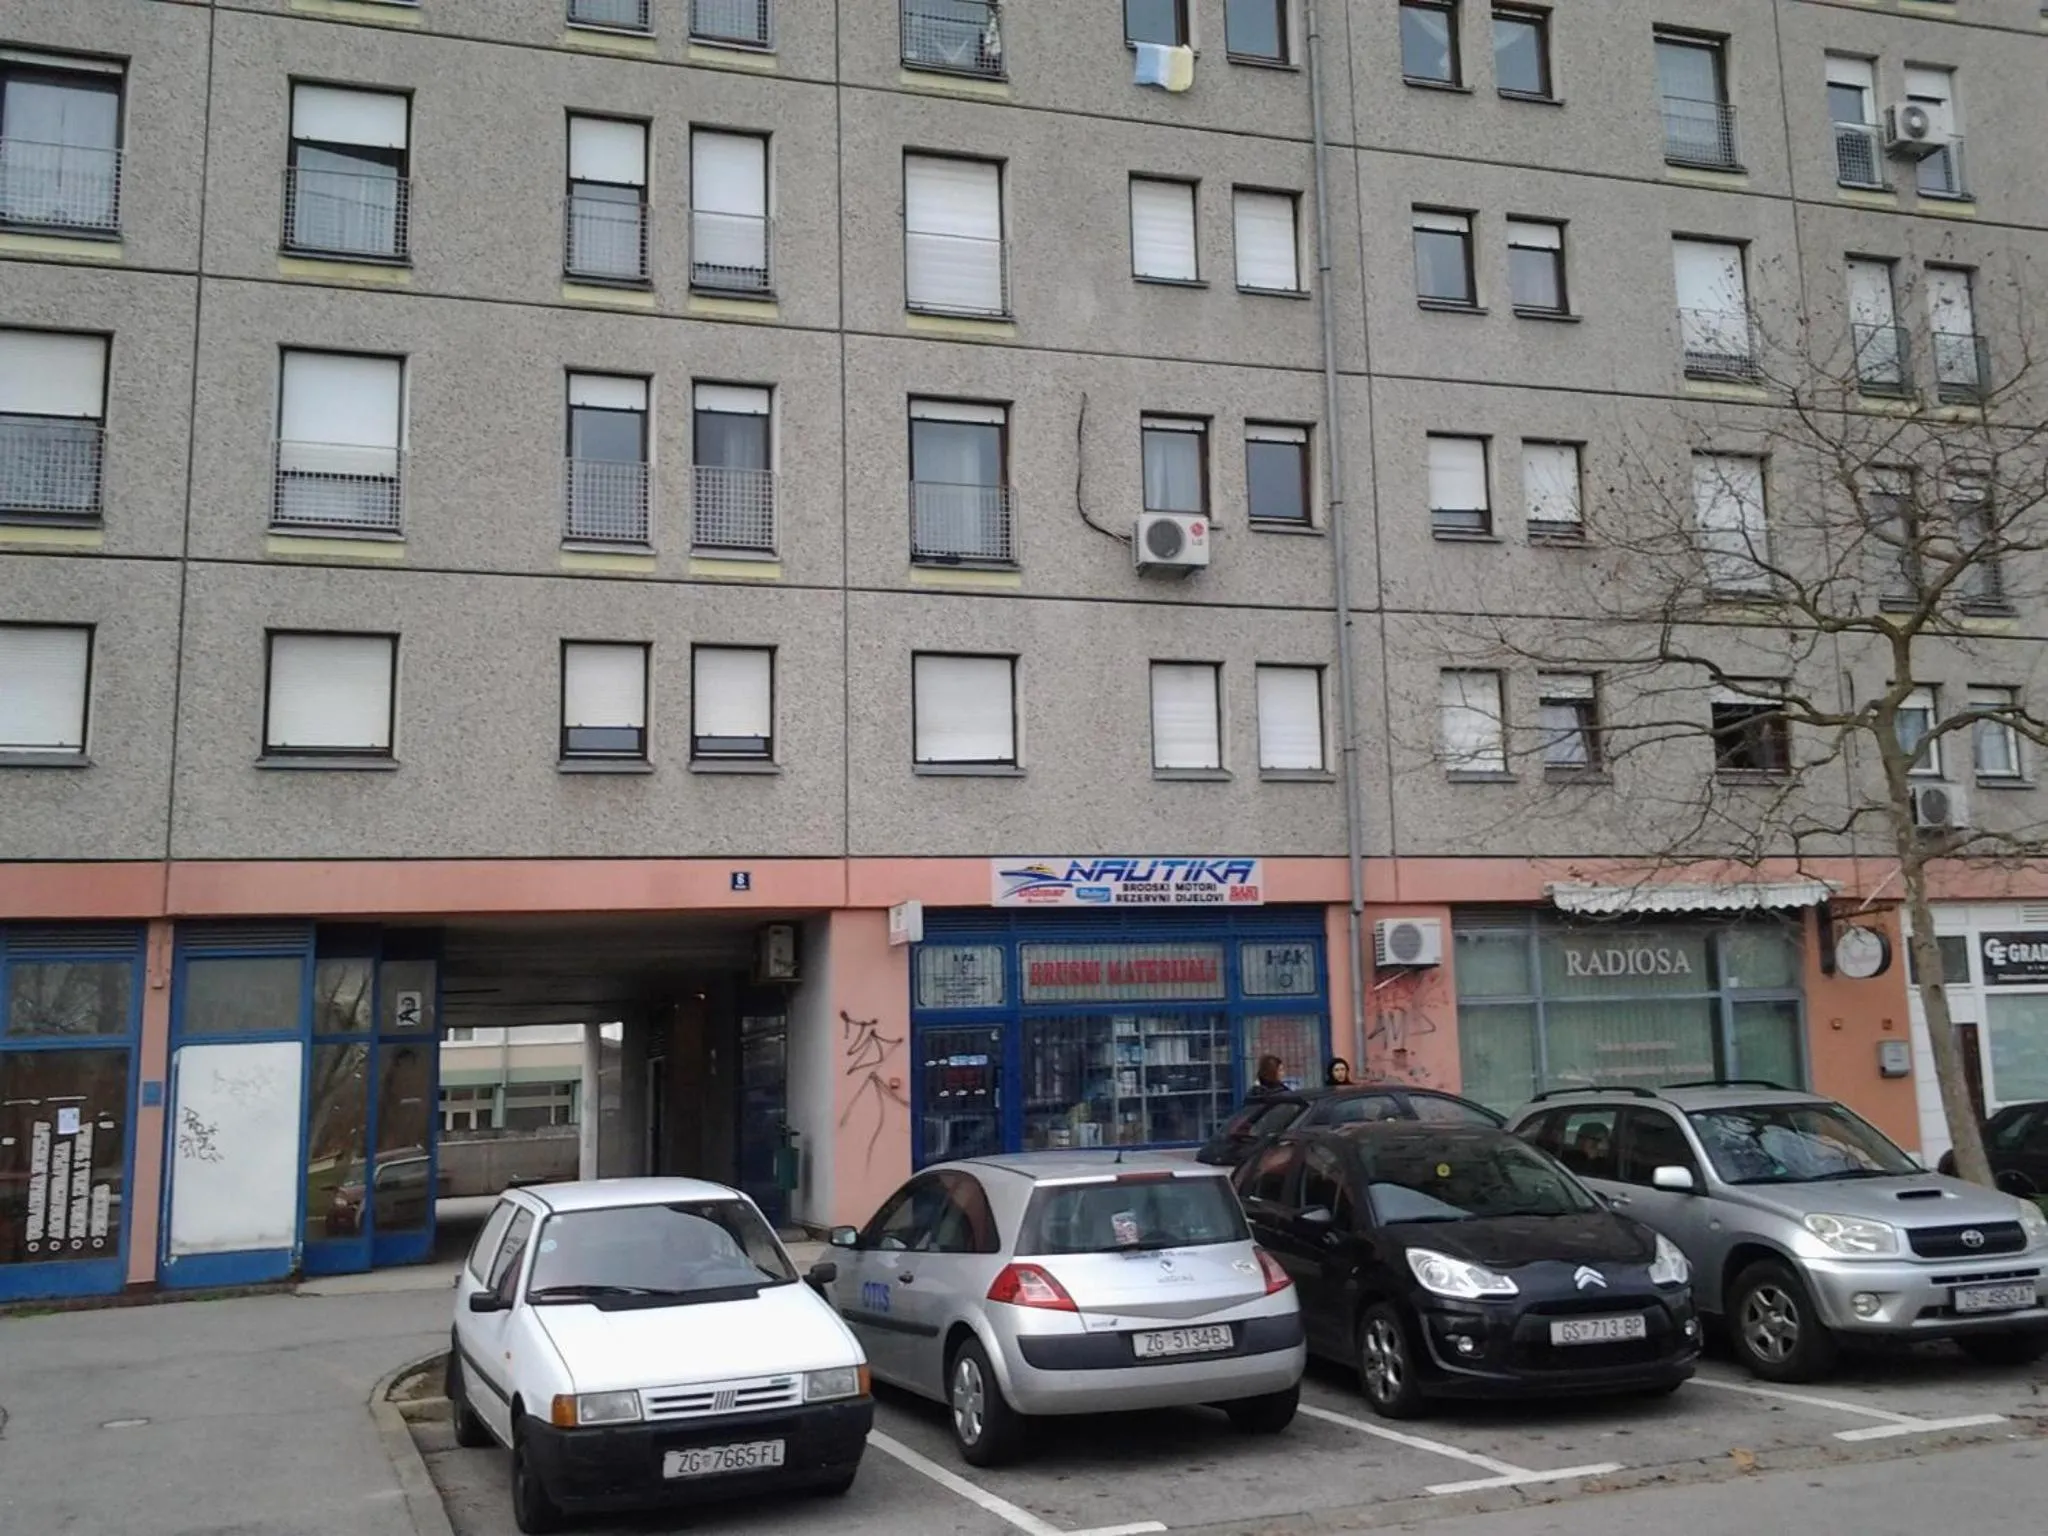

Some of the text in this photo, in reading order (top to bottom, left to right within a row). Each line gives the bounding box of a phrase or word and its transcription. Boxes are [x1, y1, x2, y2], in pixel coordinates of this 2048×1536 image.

[1063, 860, 1257, 884] NAUTIKA
[1175, 882, 1217, 892] MOTORI
[1565, 948, 1693, 976] RADIOSA
[1144, 1333, 1165, 1353] ZG
[678, 1452, 701, 1473] ZG
